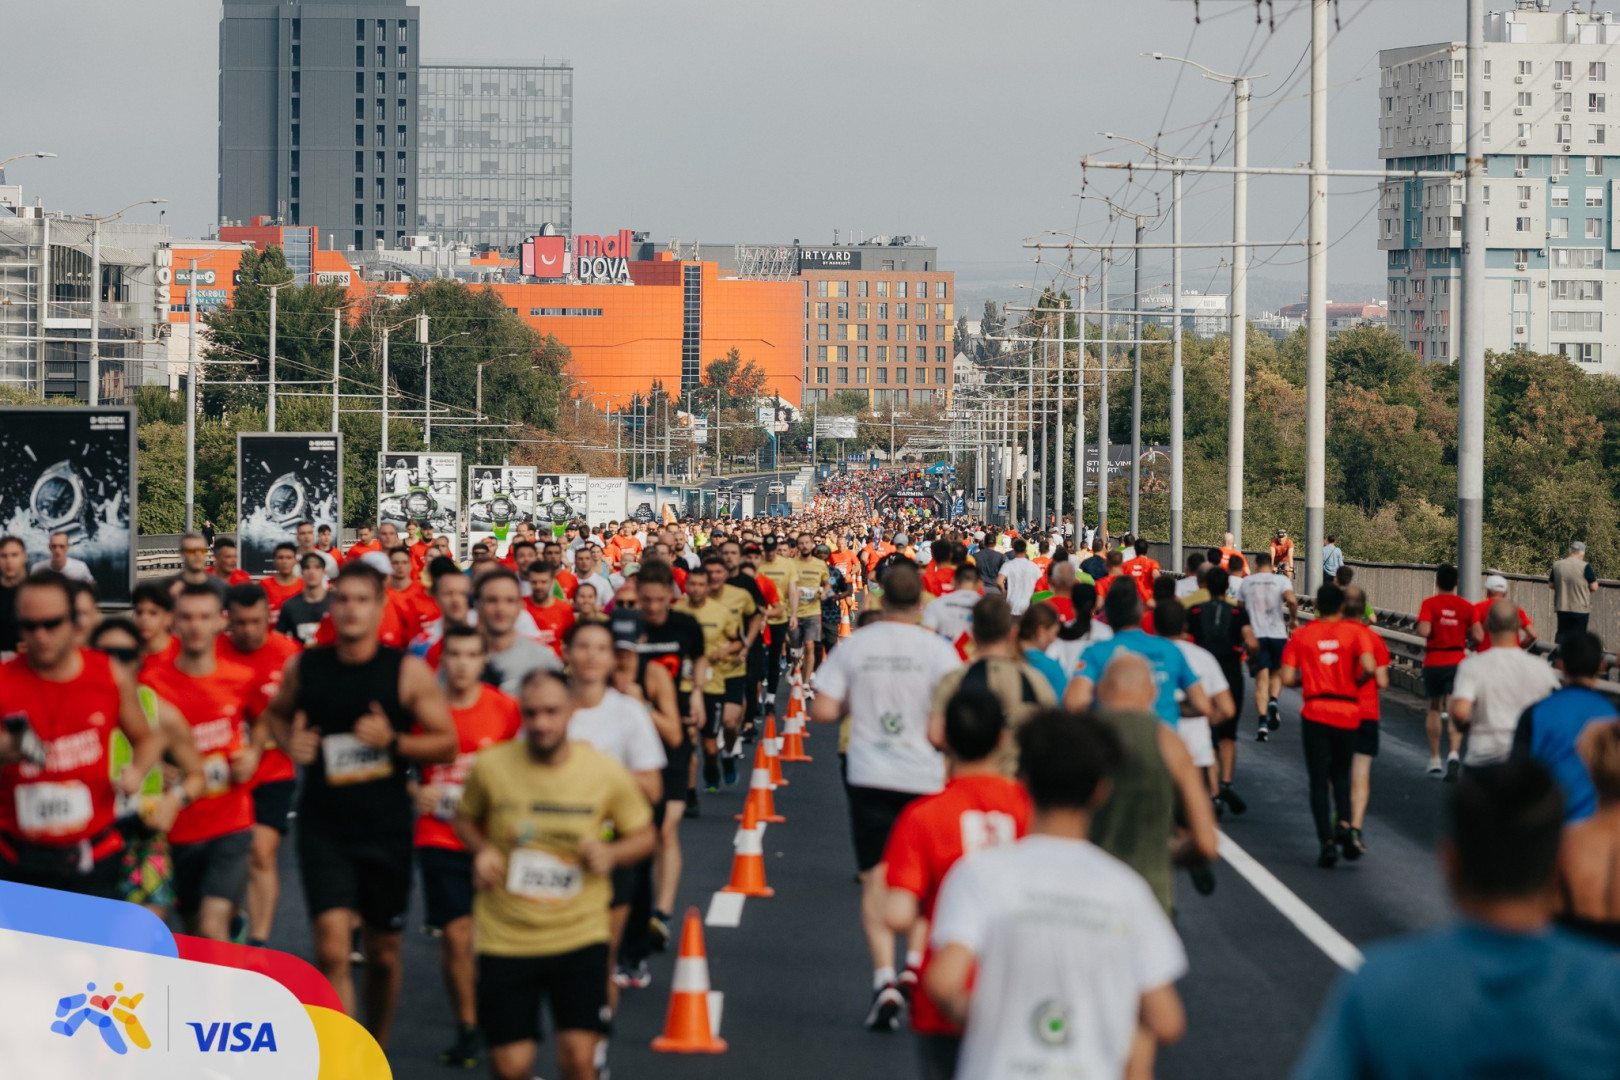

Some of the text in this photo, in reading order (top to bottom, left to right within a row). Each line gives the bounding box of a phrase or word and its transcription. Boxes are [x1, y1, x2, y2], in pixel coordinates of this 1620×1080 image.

[578, 229, 632, 257] mall
[319, 274, 349, 283] GUESS
[579, 257, 630, 279] DOVA
[157, 249, 172, 321] MOST
